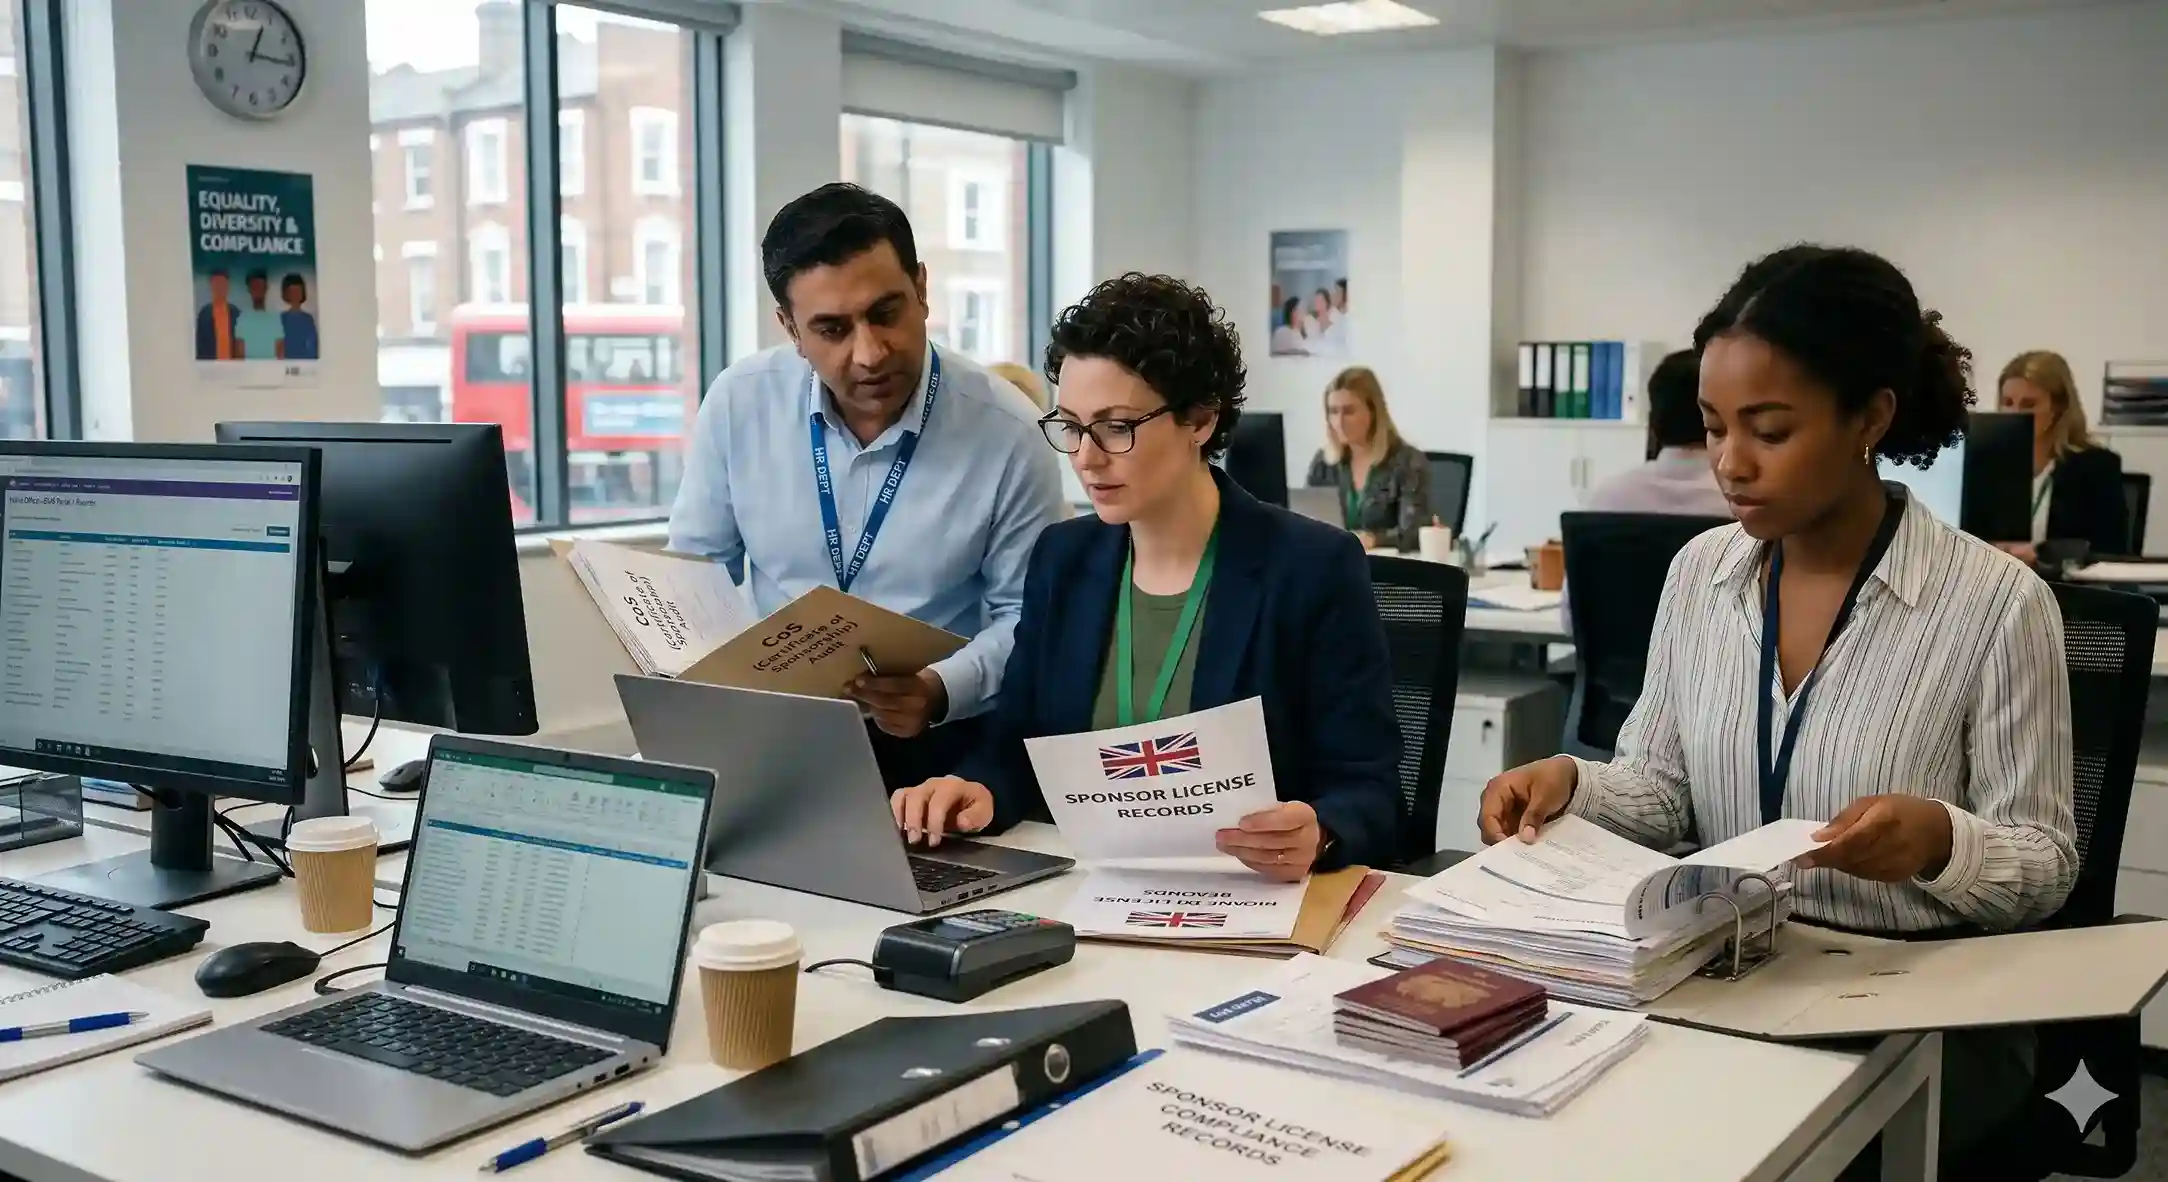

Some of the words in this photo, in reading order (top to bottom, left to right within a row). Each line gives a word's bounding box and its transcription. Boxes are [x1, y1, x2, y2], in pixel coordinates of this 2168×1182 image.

[207, 42, 219, 58] 9
[198, 190, 280, 216] EQUALITY,
[200, 212, 282, 234] DIVERSITY
[285, 216, 299, 234] &
[200, 233, 304, 255] COMPLIANCE
[814, 447, 825, 464] HR
[817, 466, 831, 495] DEPT
[887, 459, 906, 487] DEPT
[880, 487, 895, 504] HR
[827, 528, 838, 545] HR
[848, 559, 861, 576] HR
[855, 531, 873, 559] DEPT
[808, 640, 846, 665] Audit
[1064, 788, 1167, 804] SPONSOR
[1172, 772, 1257, 799] LICENSE
[1117, 802, 1214, 819] RECORDS
[1146, 1081, 1262, 1124] SPONSOR
[1264, 1117, 1372, 1158] LICENSE
[1160, 1103, 1321, 1159] COMPLIANCE
[1160, 1120, 1282, 1166] RECORDS
